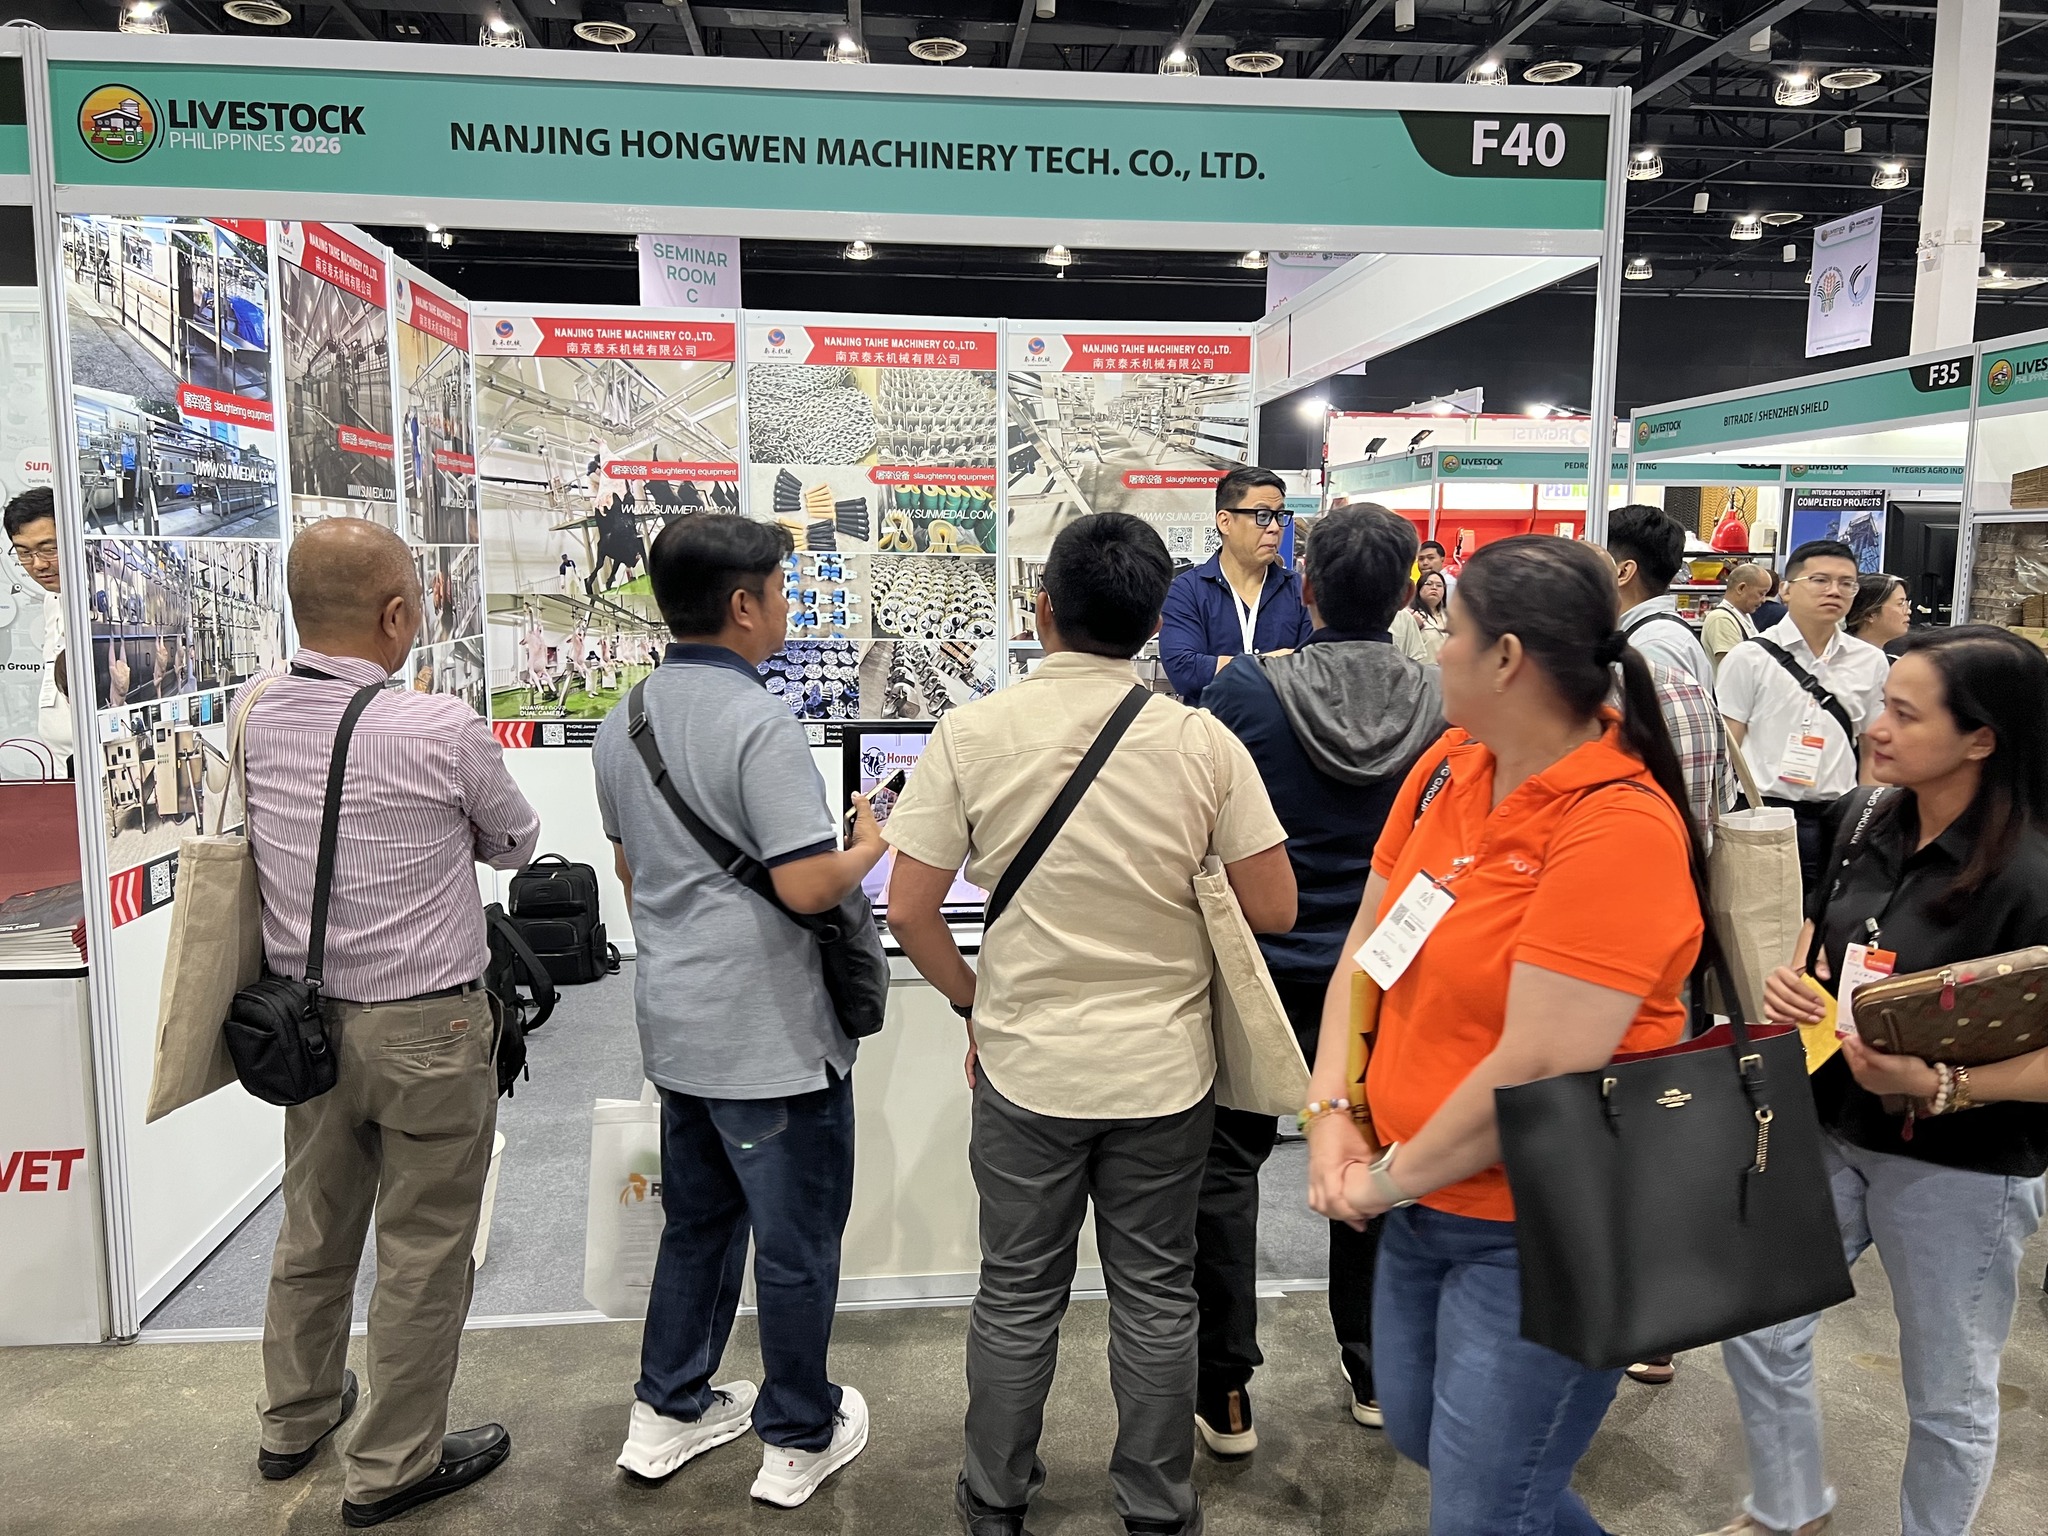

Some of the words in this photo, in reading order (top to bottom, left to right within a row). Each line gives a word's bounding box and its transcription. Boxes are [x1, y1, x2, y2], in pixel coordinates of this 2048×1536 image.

[168, 99, 367, 135] LIVESTOCK
[169, 131, 286, 152] PHILIPPINES
[290, 135, 341, 154] 2026
[1472, 120, 1566, 167] F40
[450, 122, 611, 156] NANJING
[620, 129, 806, 164] HONGWEN
[817, 138, 1018, 172] MACHINERY
[1025, 145, 1120, 175] TECH.
[1129, 149, 1191, 181] CO.,
[1201, 151, 1266, 180] LTD.
[653, 242, 728, 268] SEMINAR
[667, 265, 716, 286] ROOM
[686, 288, 698, 303] C
[554, 327, 594, 339] NANJING
[596, 328, 622, 340] TAIHE
[624, 329, 676, 341] MACHINERY
[824, 336, 862, 347] NANJING
[864, 337, 889, 348] TAIHE
[891, 338, 941, 349] MACHINERY
[1082, 343, 1119, 354] NANJING
[1121, 344, 1145, 354] TAIHE
[1147, 344, 1195, 355] MACHINERY
[566, 342, 697, 357] 南京泰禾机械有限公司
[835, 351, 960, 366] 南京泰禾机械有限公司
[1092, 357, 1214, 370] 南京泰禾机械有限公司
[1929, 362, 1960, 386] F35
[1723, 412, 1754, 426] BITRADE
[1758, 404, 1799, 422] SHENZHEN
[1800, 400, 1829, 415] SHIELD
[1650, 420, 1682, 433] LIVESTOCK
[1461, 457, 1504, 466] LIVESTOCK
[651, 466, 696, 476] slaughtering
[697, 468, 737, 476] equipment
[913, 471, 956, 481] slaughtering
[957, 473, 995, 481] equipment
[1892, 466, 1926, 474] INTEGRIS
[1165, 475, 1208, 485] slaughtering
[1797, 497, 1842, 507] COMPLETED
[1843, 497, 1881, 507] PROJECTS
[885, 508, 994, 520] WWW.SUNMEDAL.COM
[7, 662, 41, 673] Group
